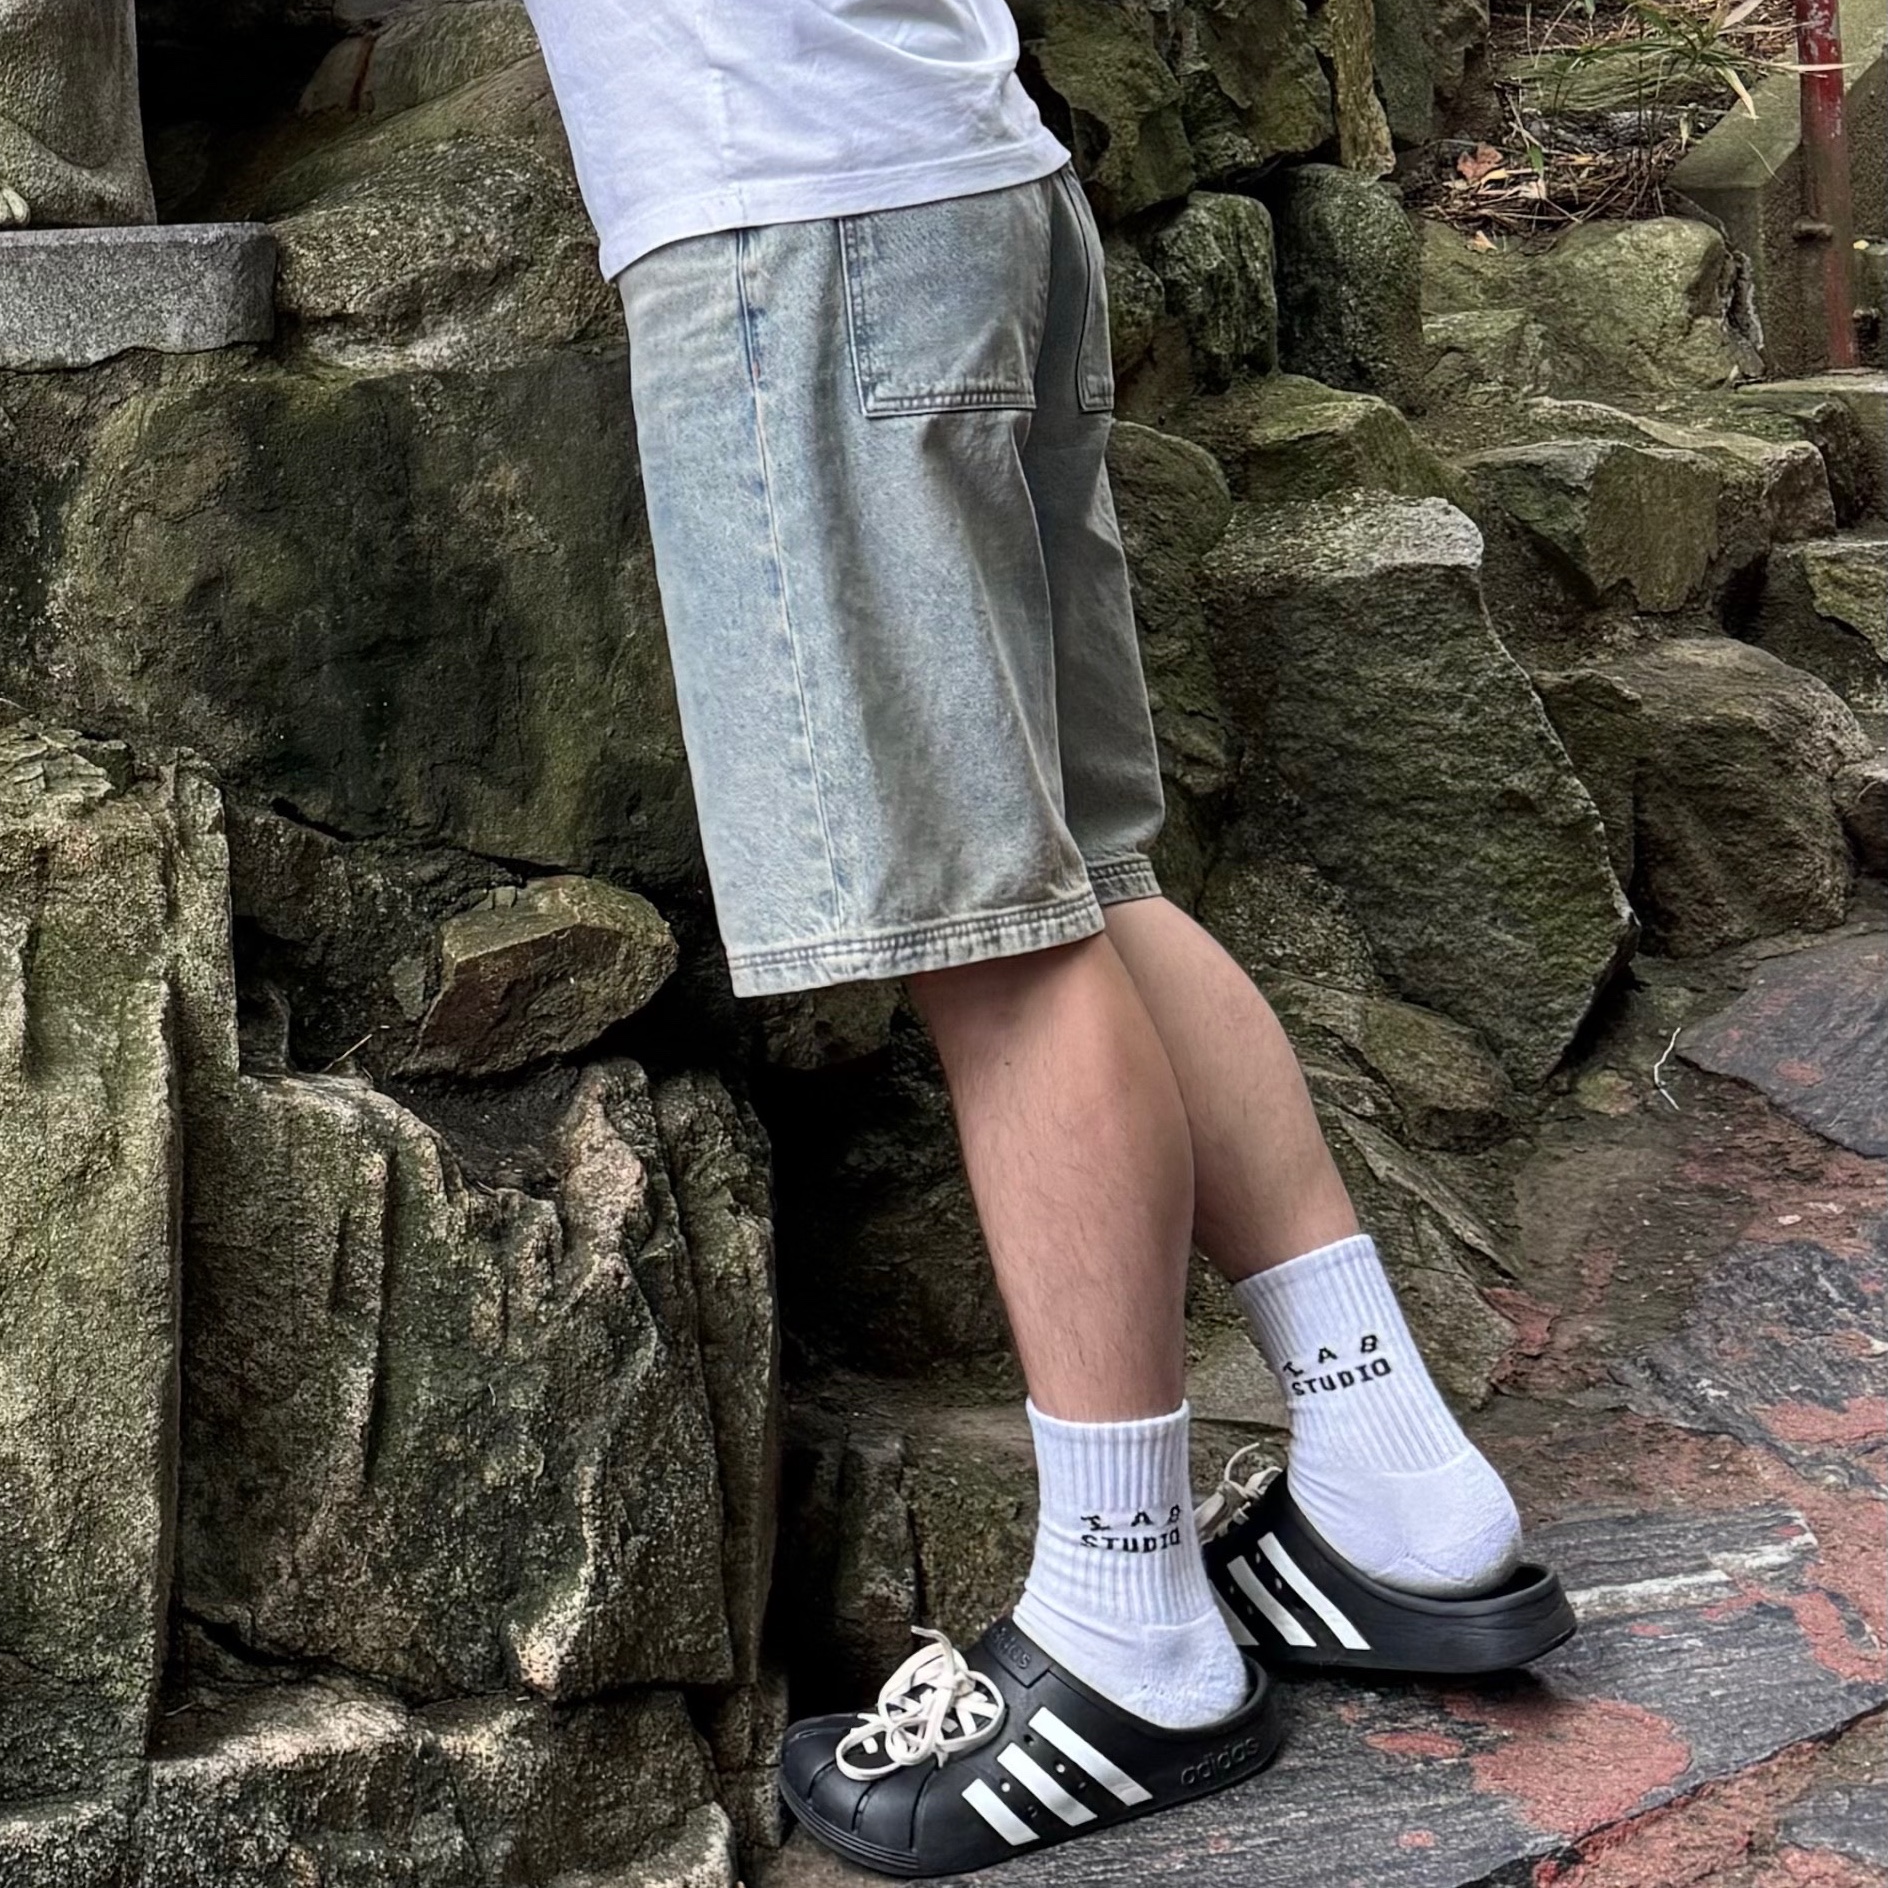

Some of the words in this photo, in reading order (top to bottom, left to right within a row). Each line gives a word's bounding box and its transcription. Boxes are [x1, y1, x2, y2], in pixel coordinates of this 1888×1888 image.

[1291, 1358, 1391, 1396] STUDIO
[1080, 1527, 1180, 1553] STUDIO
[1180, 1737, 1259, 1785] adidas
